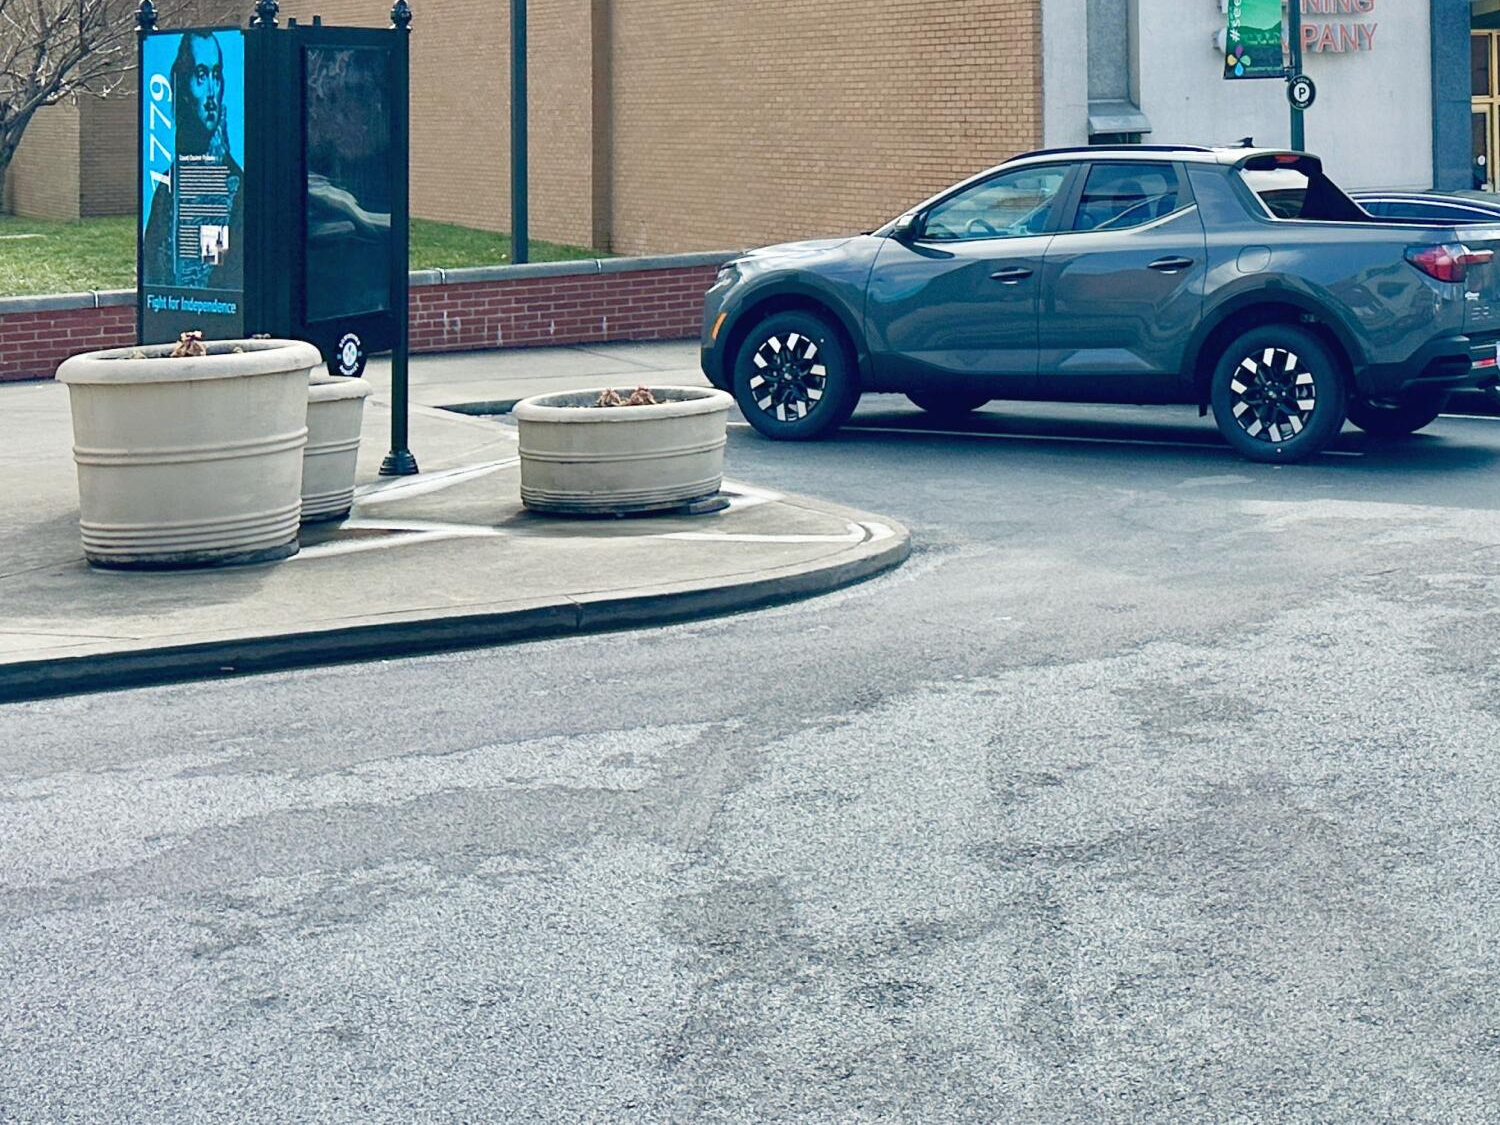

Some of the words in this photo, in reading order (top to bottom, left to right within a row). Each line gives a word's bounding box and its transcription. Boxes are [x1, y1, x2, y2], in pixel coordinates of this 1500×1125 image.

[1298, 86, 1307, 100] P
[149, 73, 172, 193] 1779
[147, 294, 167, 313] Fight
[168, 296, 180, 310] for
[181, 296, 236, 315] Independence
